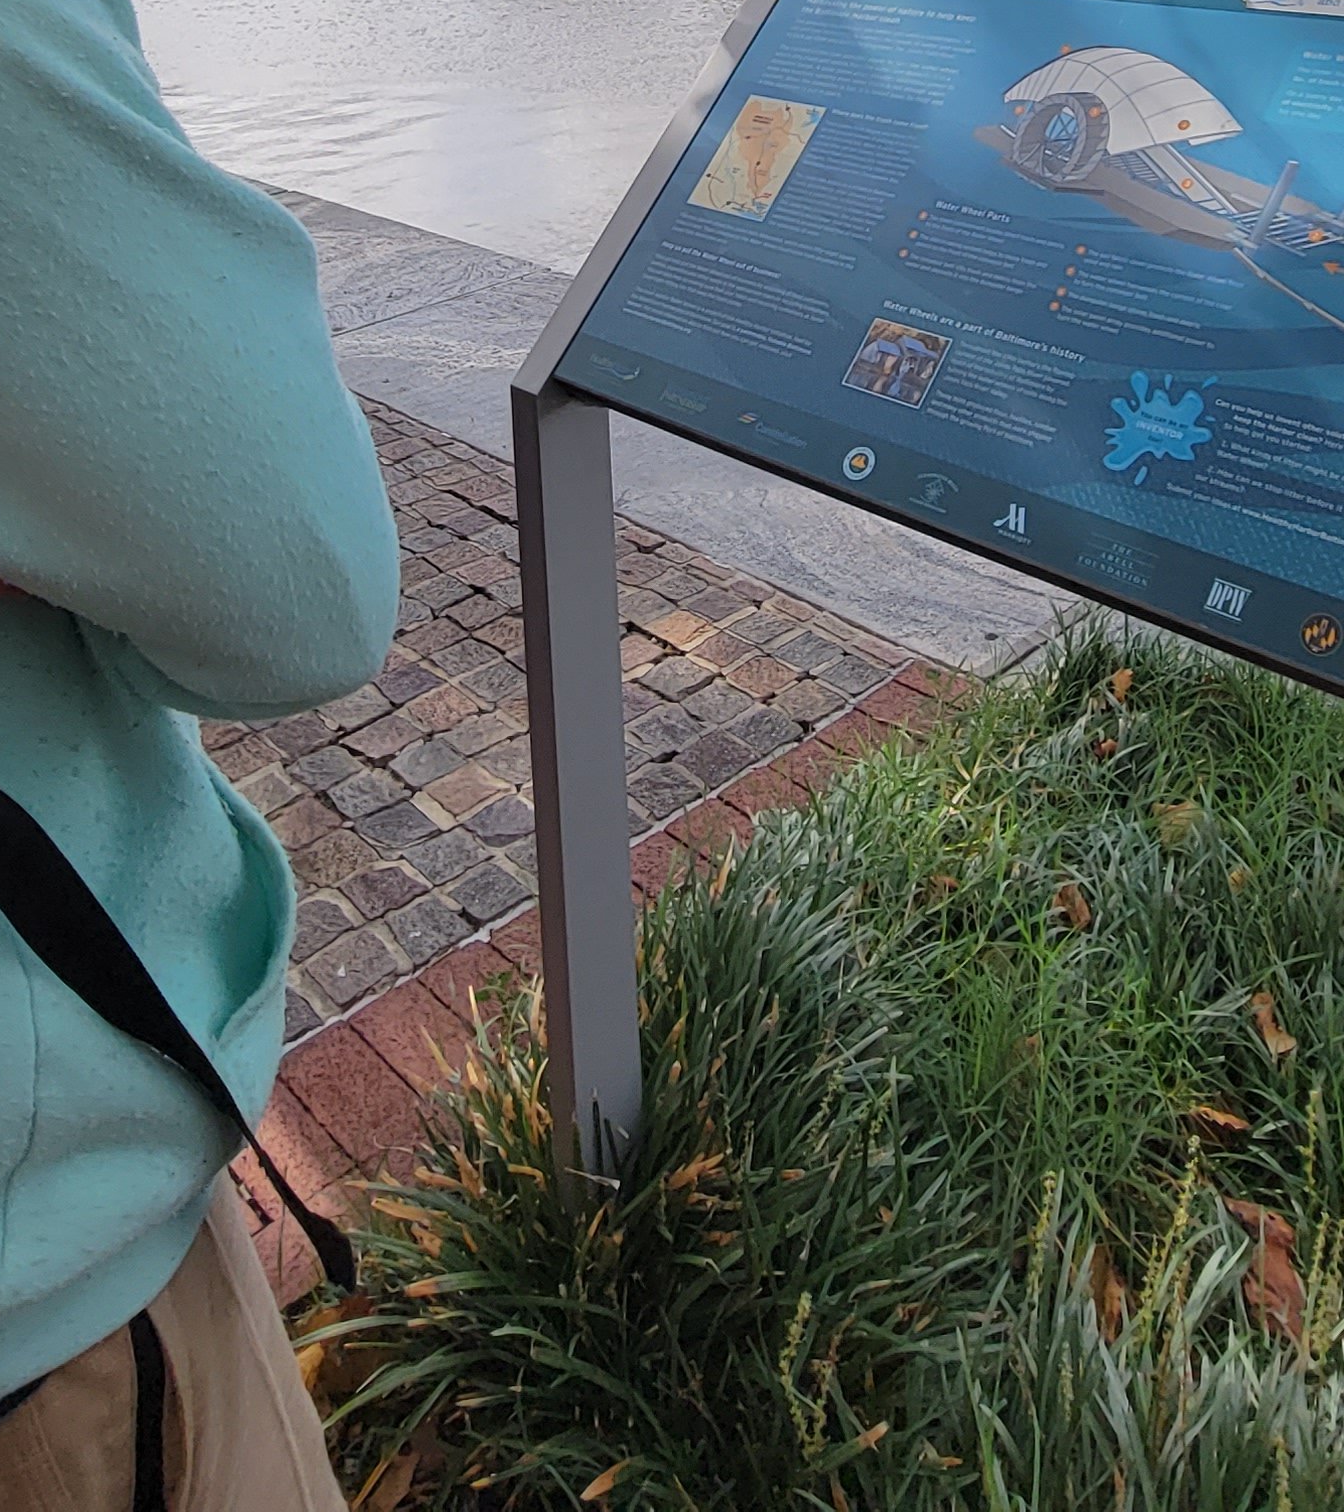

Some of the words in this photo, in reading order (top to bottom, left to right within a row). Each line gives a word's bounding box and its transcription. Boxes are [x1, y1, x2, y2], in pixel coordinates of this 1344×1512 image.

[935, 200, 960, 211] Water
[960, 205, 986, 217] Wheel
[986, 211, 1010, 222] Parts
[883, 299, 908, 313] Water
[908, 307, 938, 322] Wheels
[939, 316, 954, 326] are
[954, 320, 962, 328] a
[960, 322, 983, 335] part
[983, 328, 995, 337] of
[994, 330, 1048, 352] Baltimore's
[1049, 345, 1086, 364] history
[1135, 420, 1183, 440] INVENTOR
[1214, 398, 1230, 408] Can
[1230, 404, 1246, 412] you
[1245, 406, 1263, 418] help
[1301, 422, 1324, 433] other
[1111, 543, 1133, 557] THE
[1077, 555, 1149, 588] FOUNDATION
[1206, 582, 1249, 617] DPW
